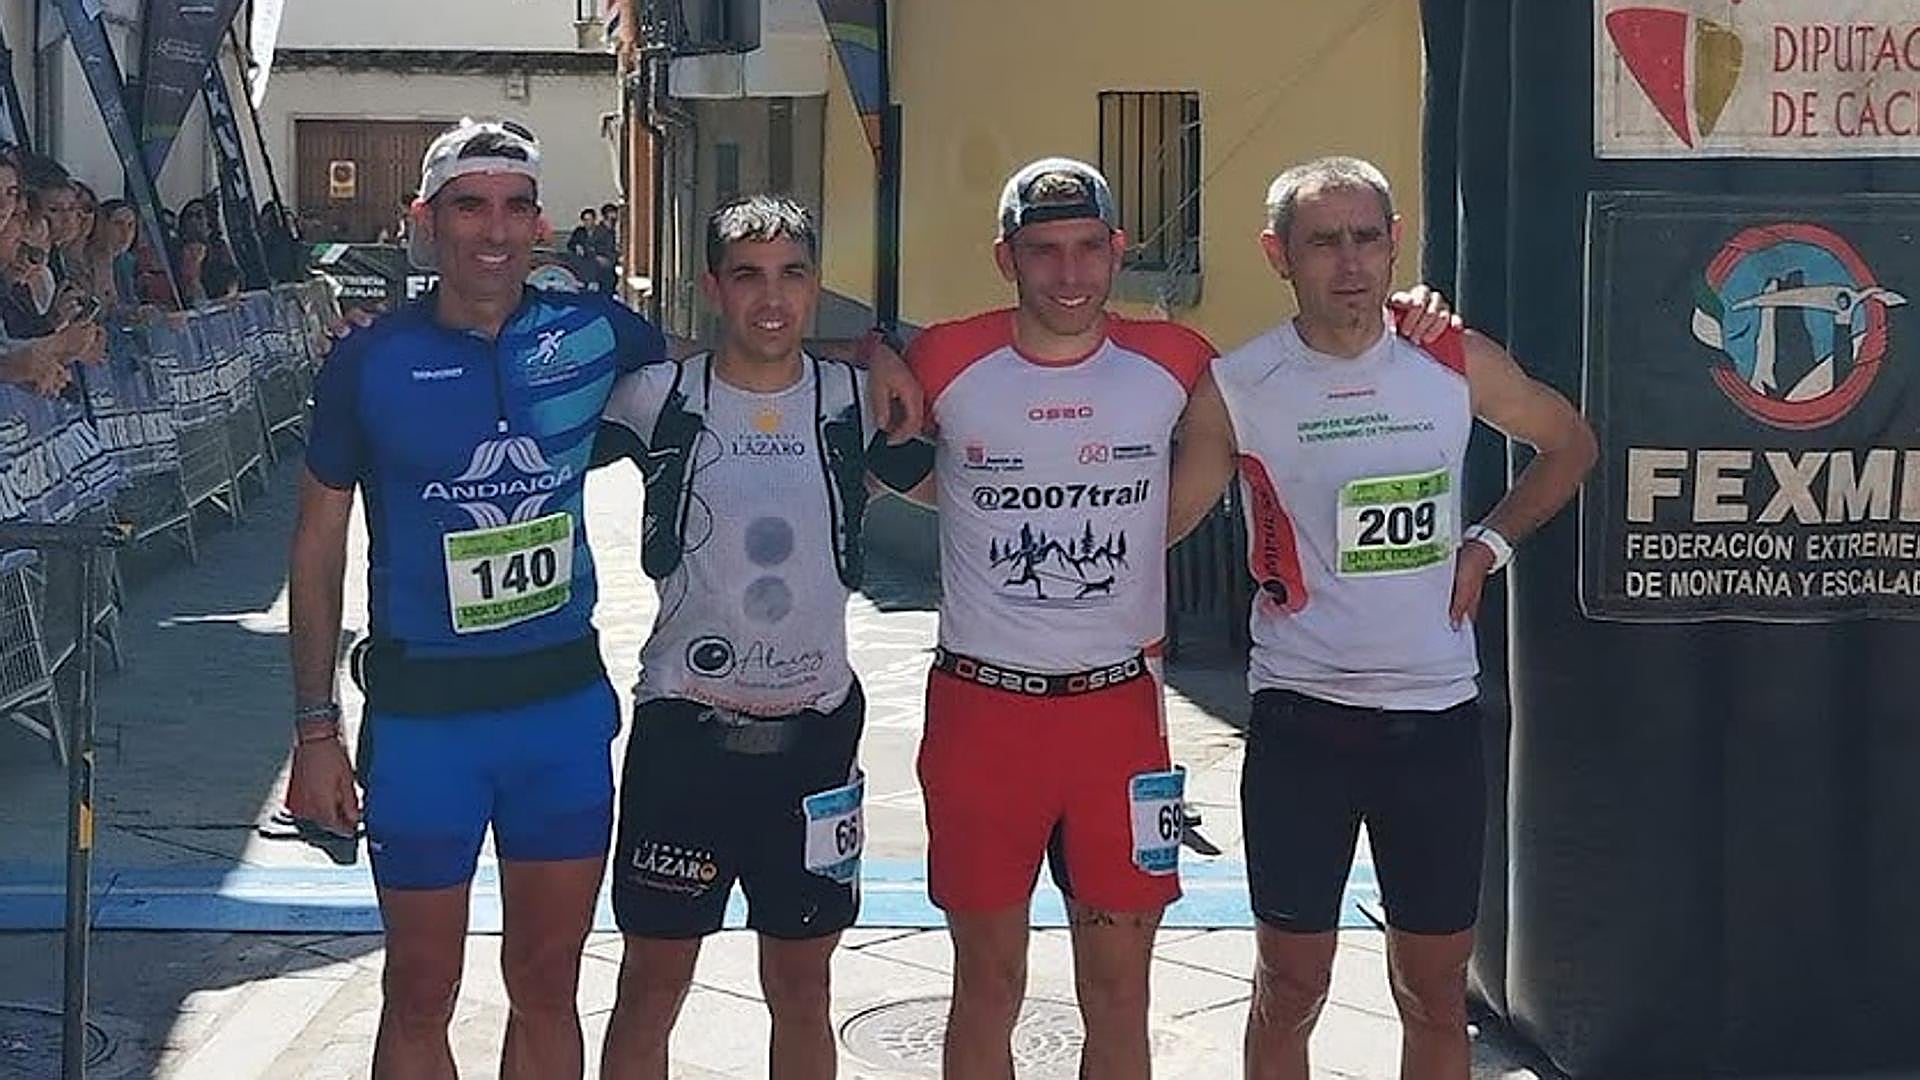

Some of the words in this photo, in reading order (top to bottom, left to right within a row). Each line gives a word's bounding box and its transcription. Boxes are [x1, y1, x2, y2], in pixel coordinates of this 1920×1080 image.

[1772, 91, 1818, 137] DE
[1836, 78, 1920, 137] CÁC
[972, 479, 1150, 511] @2007trail
[1358, 501, 1436, 546] 209
[1626, 530, 1793, 561] FEDERACIÓN
[1807, 532, 1920, 561] EXTREME
[471, 546, 558, 600] 140
[1626, 570, 1663, 598] DE
[1671, 566, 1792, 598] MONTAÑA
[1798, 572, 1817, 596] Y
[1159, 803, 1181, 841] 69
